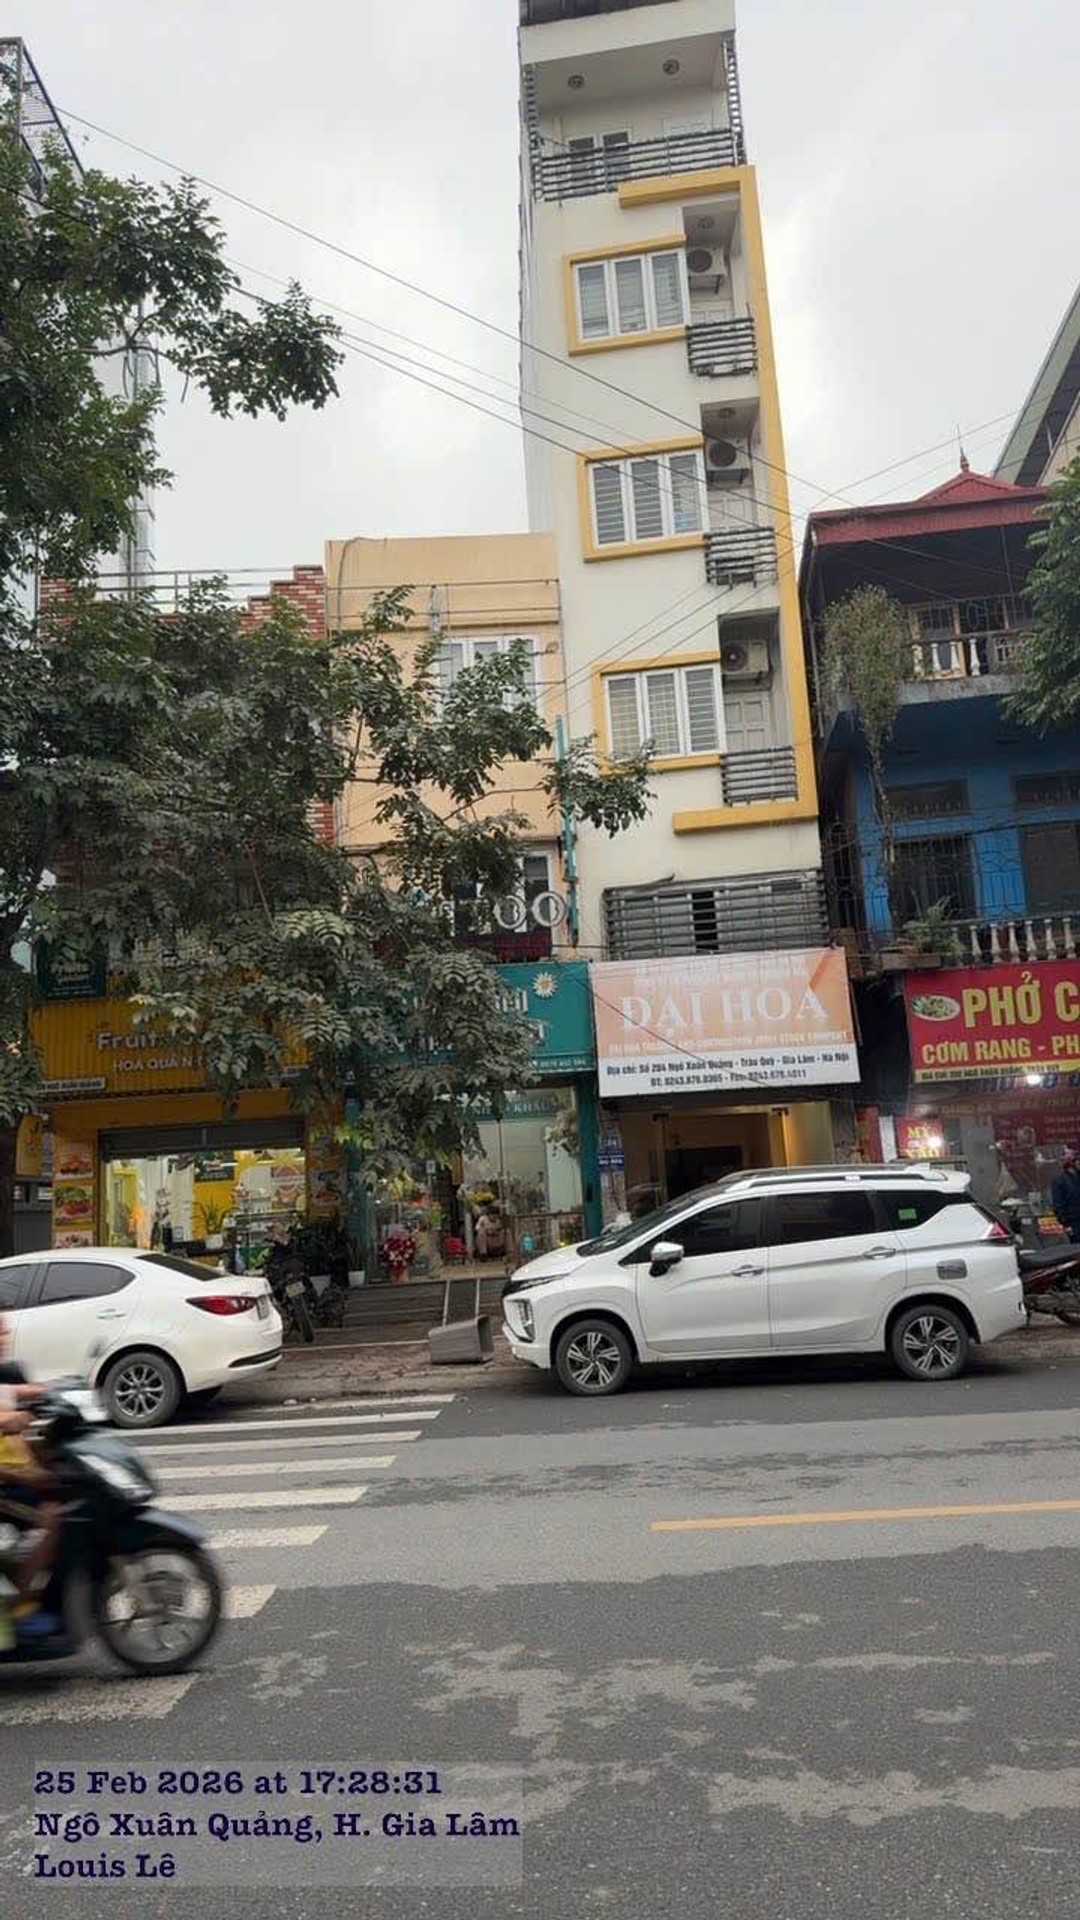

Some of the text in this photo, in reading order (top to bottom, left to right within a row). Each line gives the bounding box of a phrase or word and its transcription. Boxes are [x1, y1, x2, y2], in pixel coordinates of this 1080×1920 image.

[721, 986, 829, 1024] HOA
[961, 971, 1042, 1029] PHỞ
[922, 1041, 968, 1065] CƠM
[975, 1037, 1032, 1061] RANG
